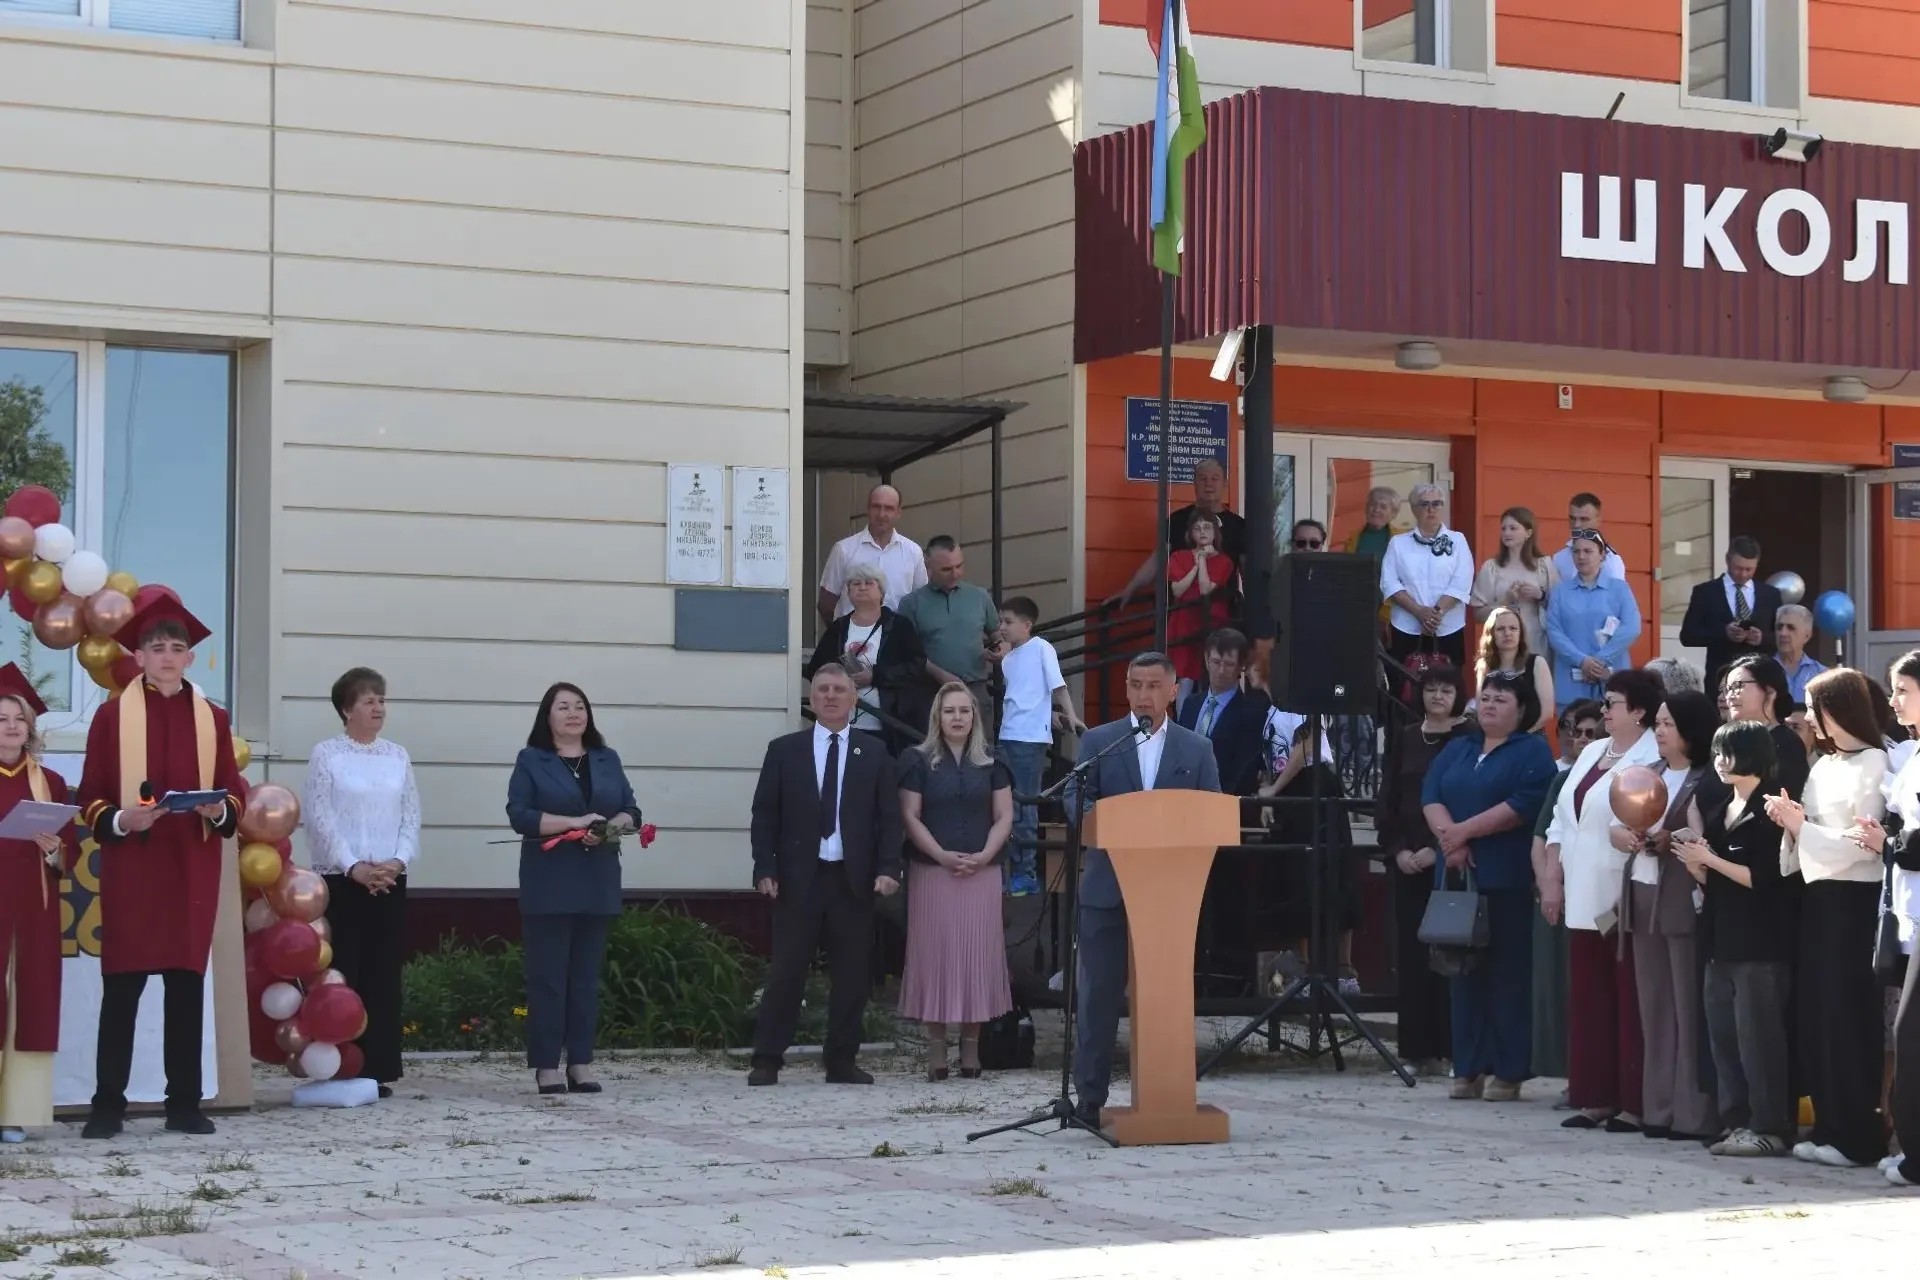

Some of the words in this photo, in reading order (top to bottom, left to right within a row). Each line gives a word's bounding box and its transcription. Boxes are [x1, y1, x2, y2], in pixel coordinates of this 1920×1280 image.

[1561, 171, 1909, 285] ШКОЛ
[1145, 423, 1186, 434] «ЙЫЙЫР
[1187, 427, 1212, 435] АУЫЛЫ
[1148, 435, 1177, 443] ИРОВ
[1179, 436, 1226, 446] ИСЕМЕНДӘГЕ
[1142, 444, 1160, 452] УРТА
[1167, 445, 1190, 453] ӨЙӨМ
[1191, 448, 1215, 456] БЕЛЕМ
